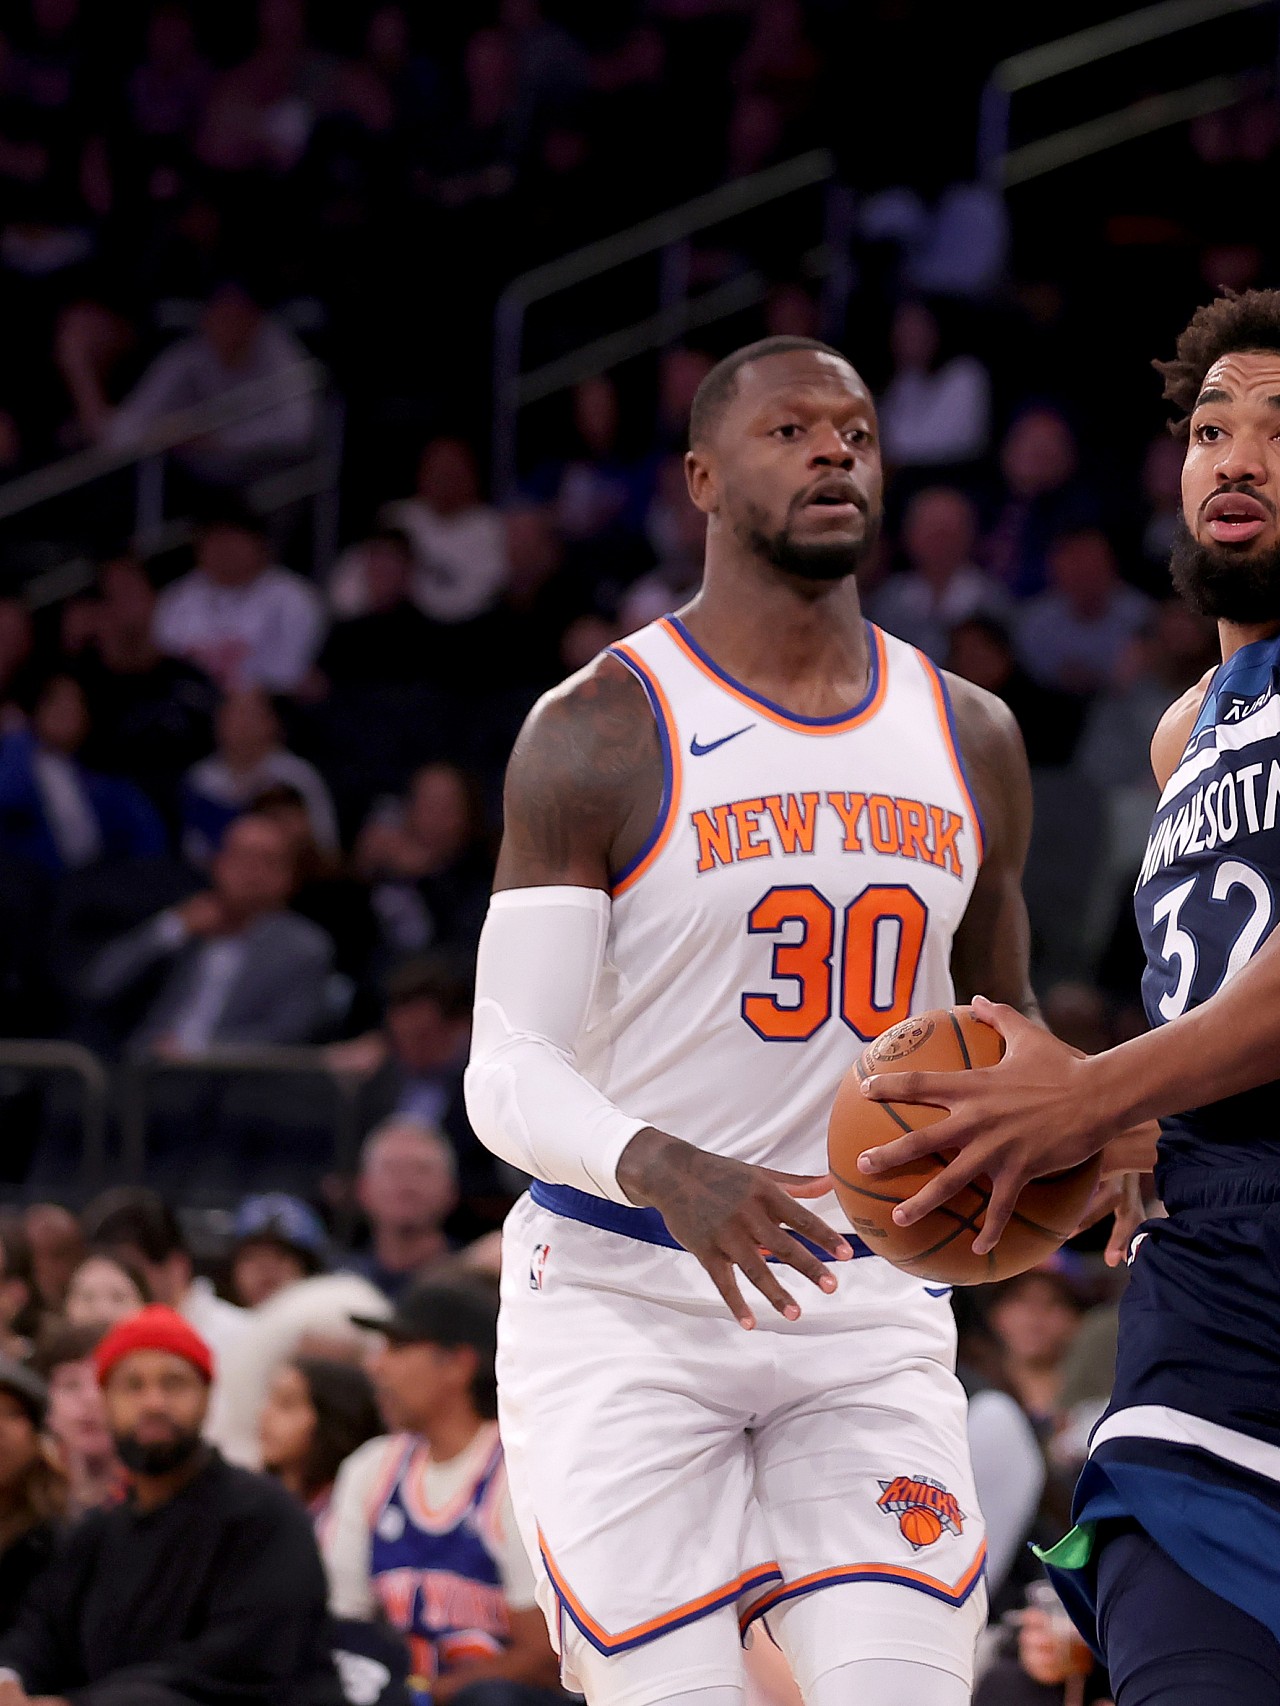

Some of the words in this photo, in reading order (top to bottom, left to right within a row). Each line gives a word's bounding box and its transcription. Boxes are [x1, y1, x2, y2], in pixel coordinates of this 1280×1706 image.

[691, 791, 820, 875] NEW
[826, 790, 964, 880] YORK
[740, 883, 930, 1042] 30
[1152, 859, 1274, 1022] 32
[876, 1475, 964, 1537] KNICKS
